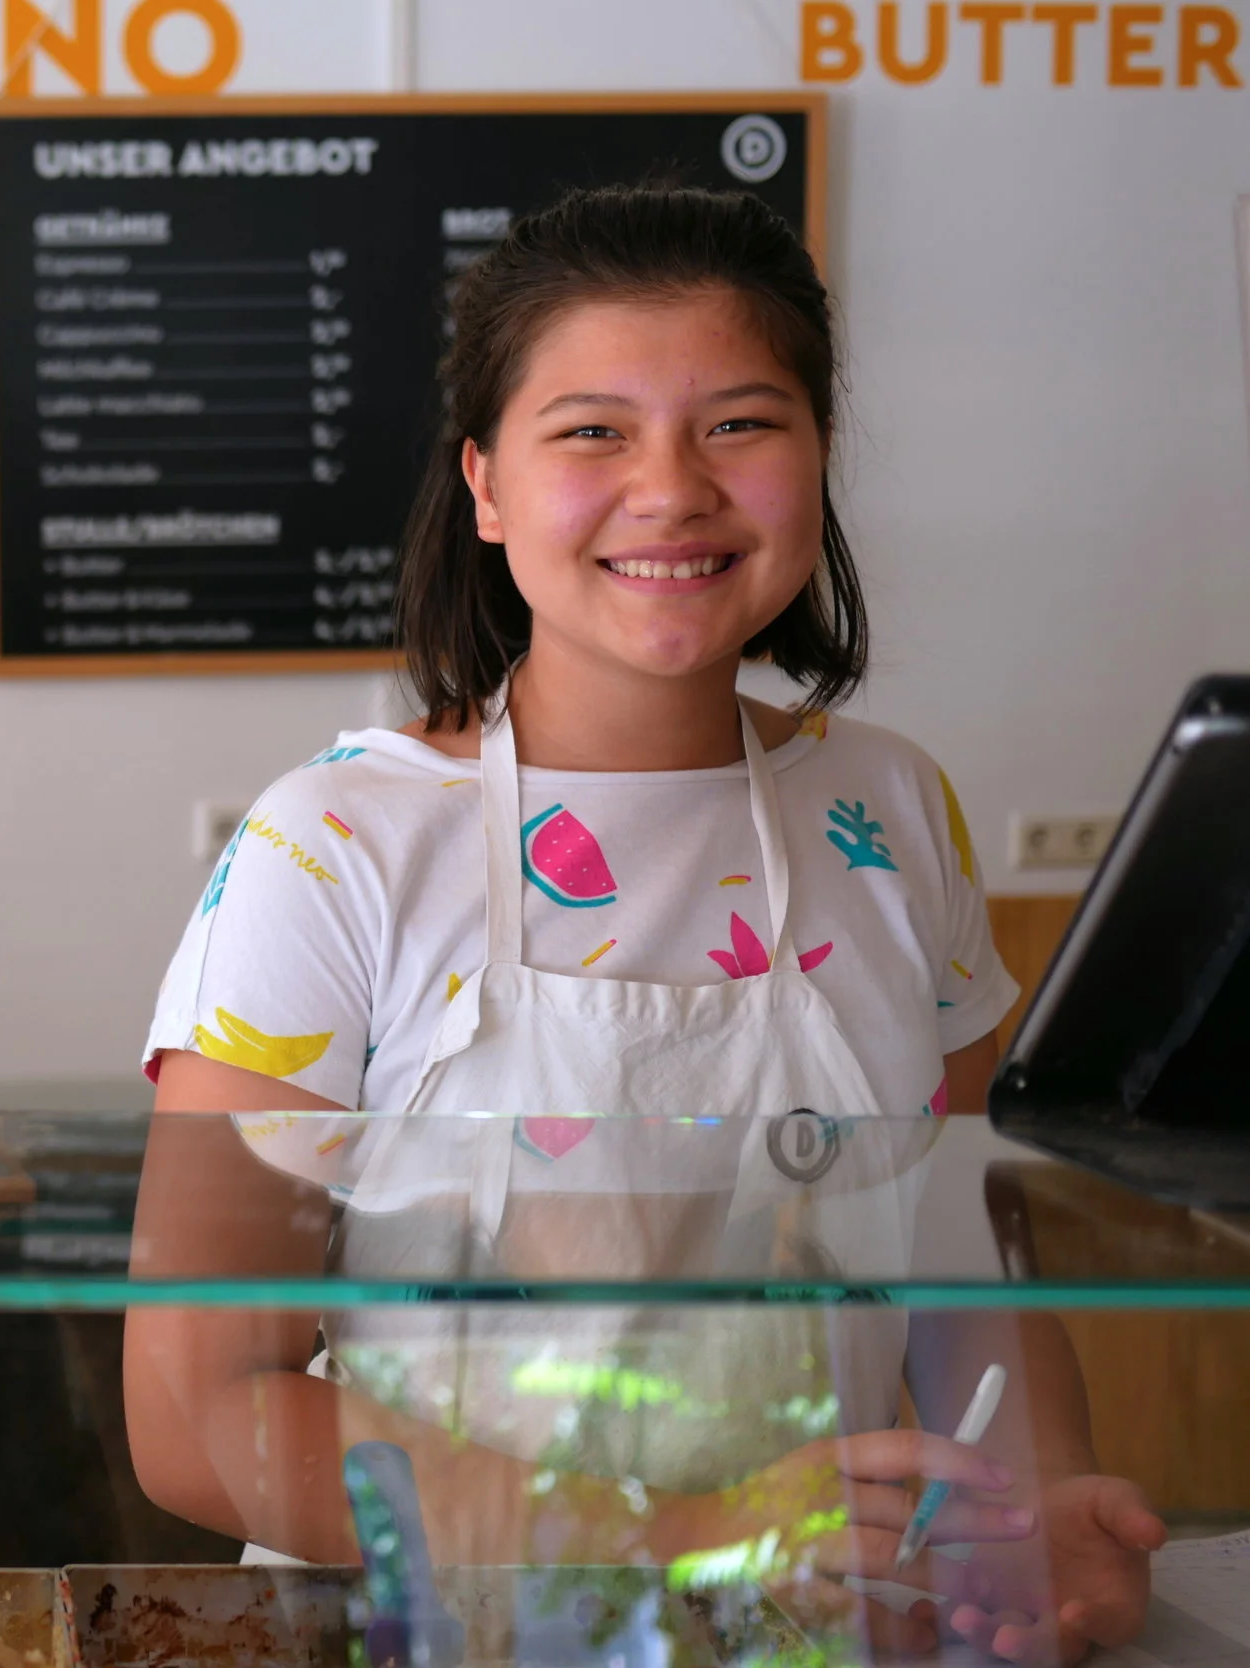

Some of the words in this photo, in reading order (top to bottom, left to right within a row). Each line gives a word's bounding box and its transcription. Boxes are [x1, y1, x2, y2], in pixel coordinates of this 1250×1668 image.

[799, 0, 1246, 89] BUTTER
[35, 140, 172, 177] UNSER
[178, 138, 377, 175] ANGEBOT
